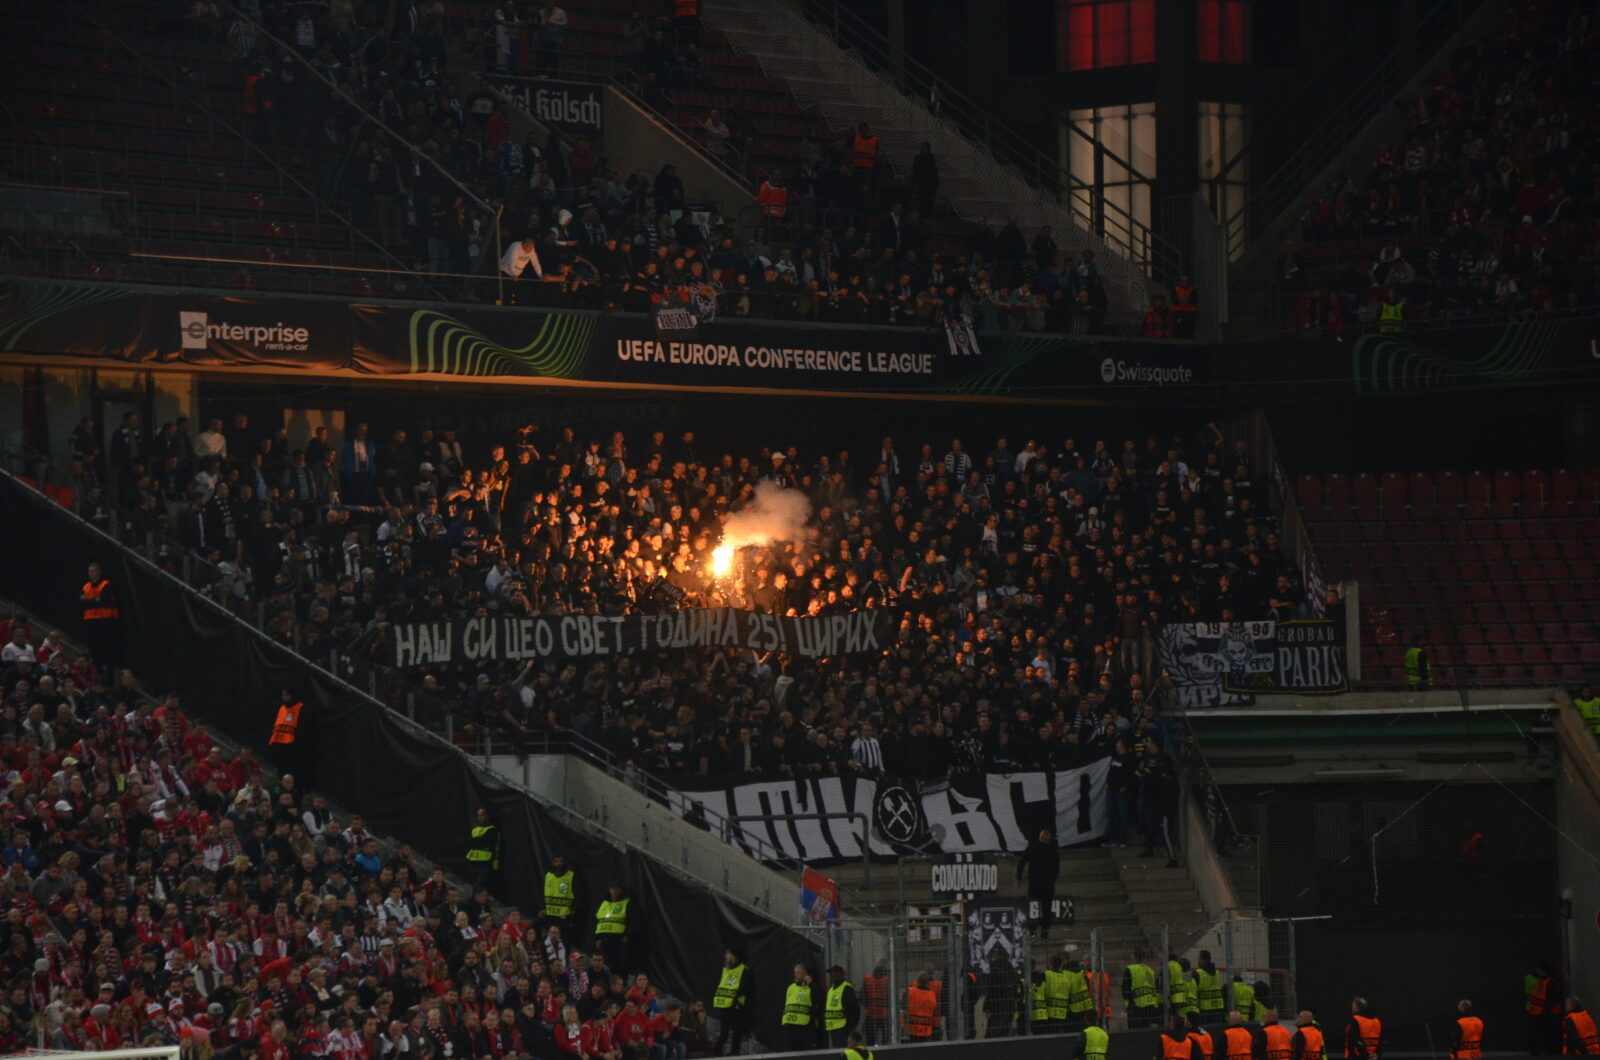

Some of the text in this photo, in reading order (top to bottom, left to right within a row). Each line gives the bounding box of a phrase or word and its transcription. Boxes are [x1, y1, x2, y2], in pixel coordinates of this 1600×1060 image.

[536, 88, 601, 130] Kölsch
[182, 321, 309, 347] enterprise
[265, 343, 309, 351] rent-a-car
[616, 339, 932, 374] UEFA EUROPA CONFERENCE LEAGUE
[1116, 360, 1193, 387] Swissquote
[394, 621, 452, 668] НАШ
[463, 616, 498, 661] СИ
[504, 617, 554, 662] ЦЕО
[640, 607, 739, 651] ГОДИНА
[747, 613, 787, 651] 25!
[795, 609, 880, 660] ЦИРИХ
[1278, 645, 1343, 688] PARIS
[932, 863, 998, 892] COMMANDO
